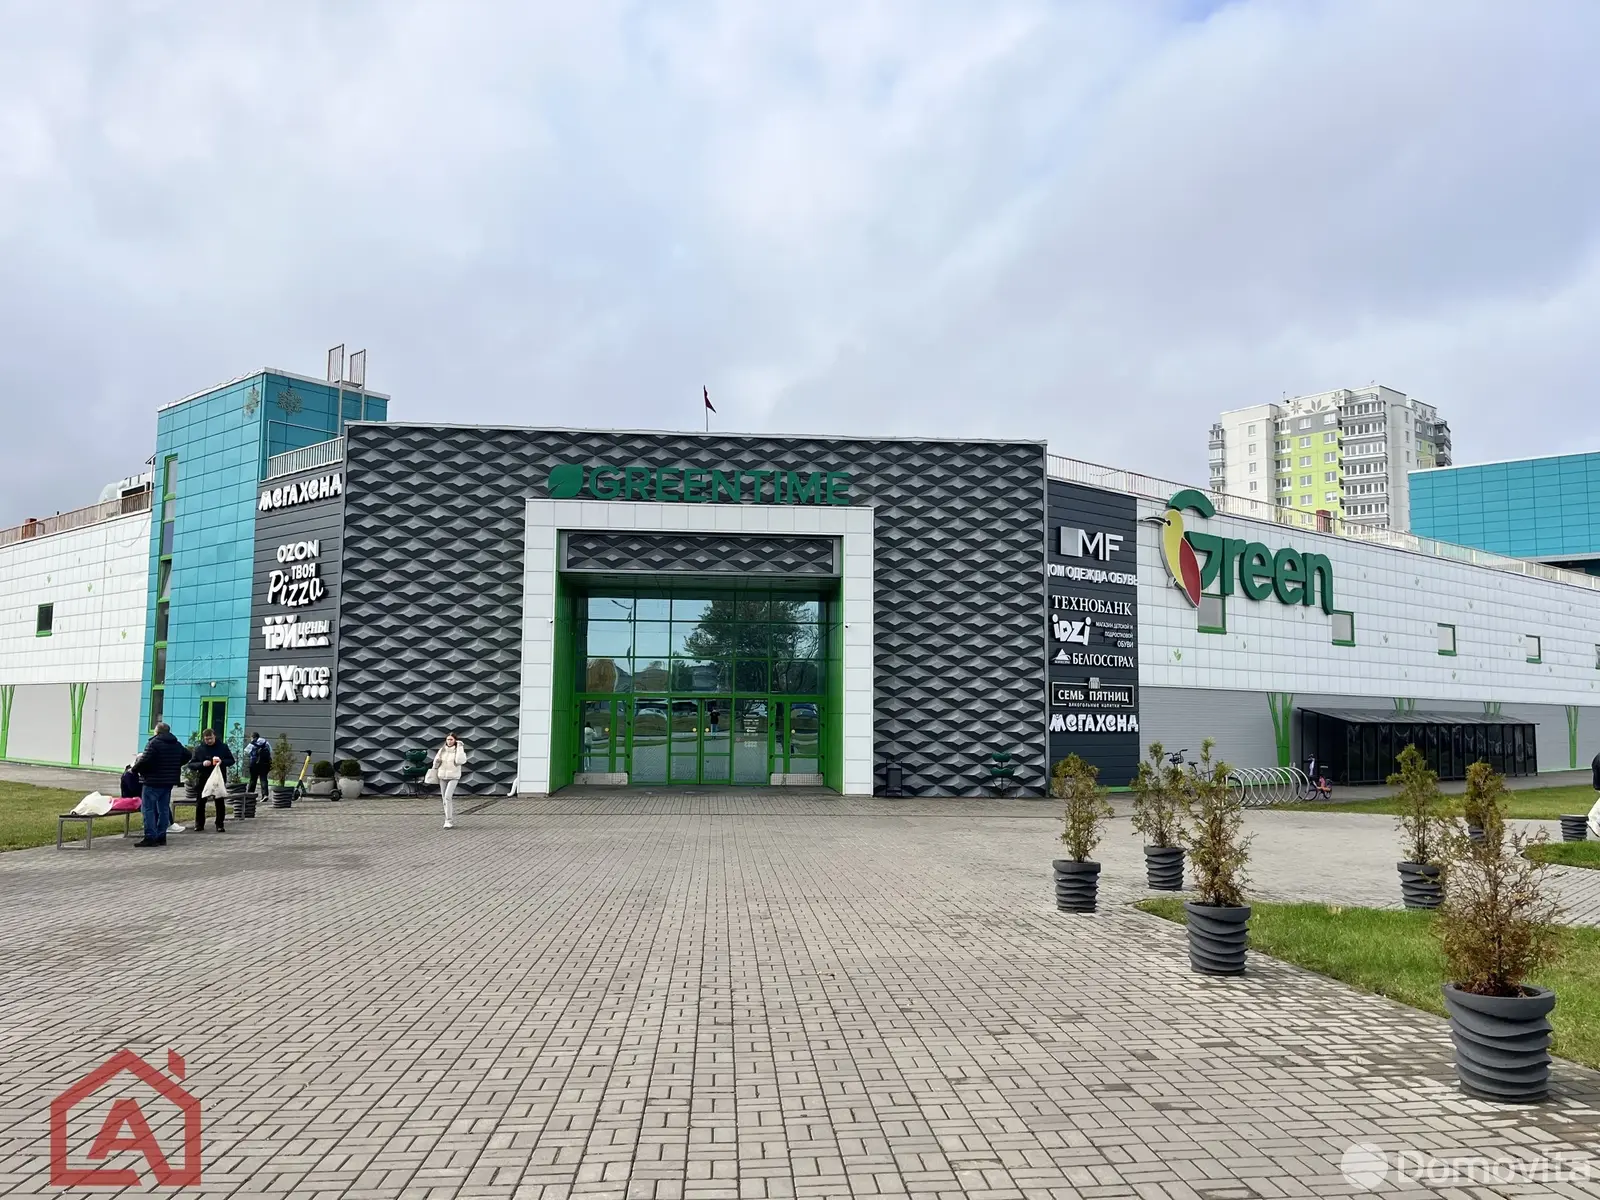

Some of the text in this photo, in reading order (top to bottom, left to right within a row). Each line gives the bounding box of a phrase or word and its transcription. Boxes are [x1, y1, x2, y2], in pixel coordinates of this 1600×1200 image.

[588, 464, 850, 506] GREENTIME
[277, 540, 319, 563] OZON
[1078, 528, 1124, 561] MF
[1160, 489, 1333, 615] Green
[291, 563, 316, 580] ТВОЯ
[1067, 566, 1108, 583] ОДЕЖДА
[267, 570, 323, 607] Pizza
[1052, 594, 1132, 616] ТЕХНОБАНК
[262, 620, 330, 649] ТРИ цены
[1117, 640, 1133, 648] ОБУВИ
[1073, 653, 1134, 668] БЕЛГОССТРАХ
[1058, 690, 1129, 703] СЕМЬ ПЯТНИЦ
